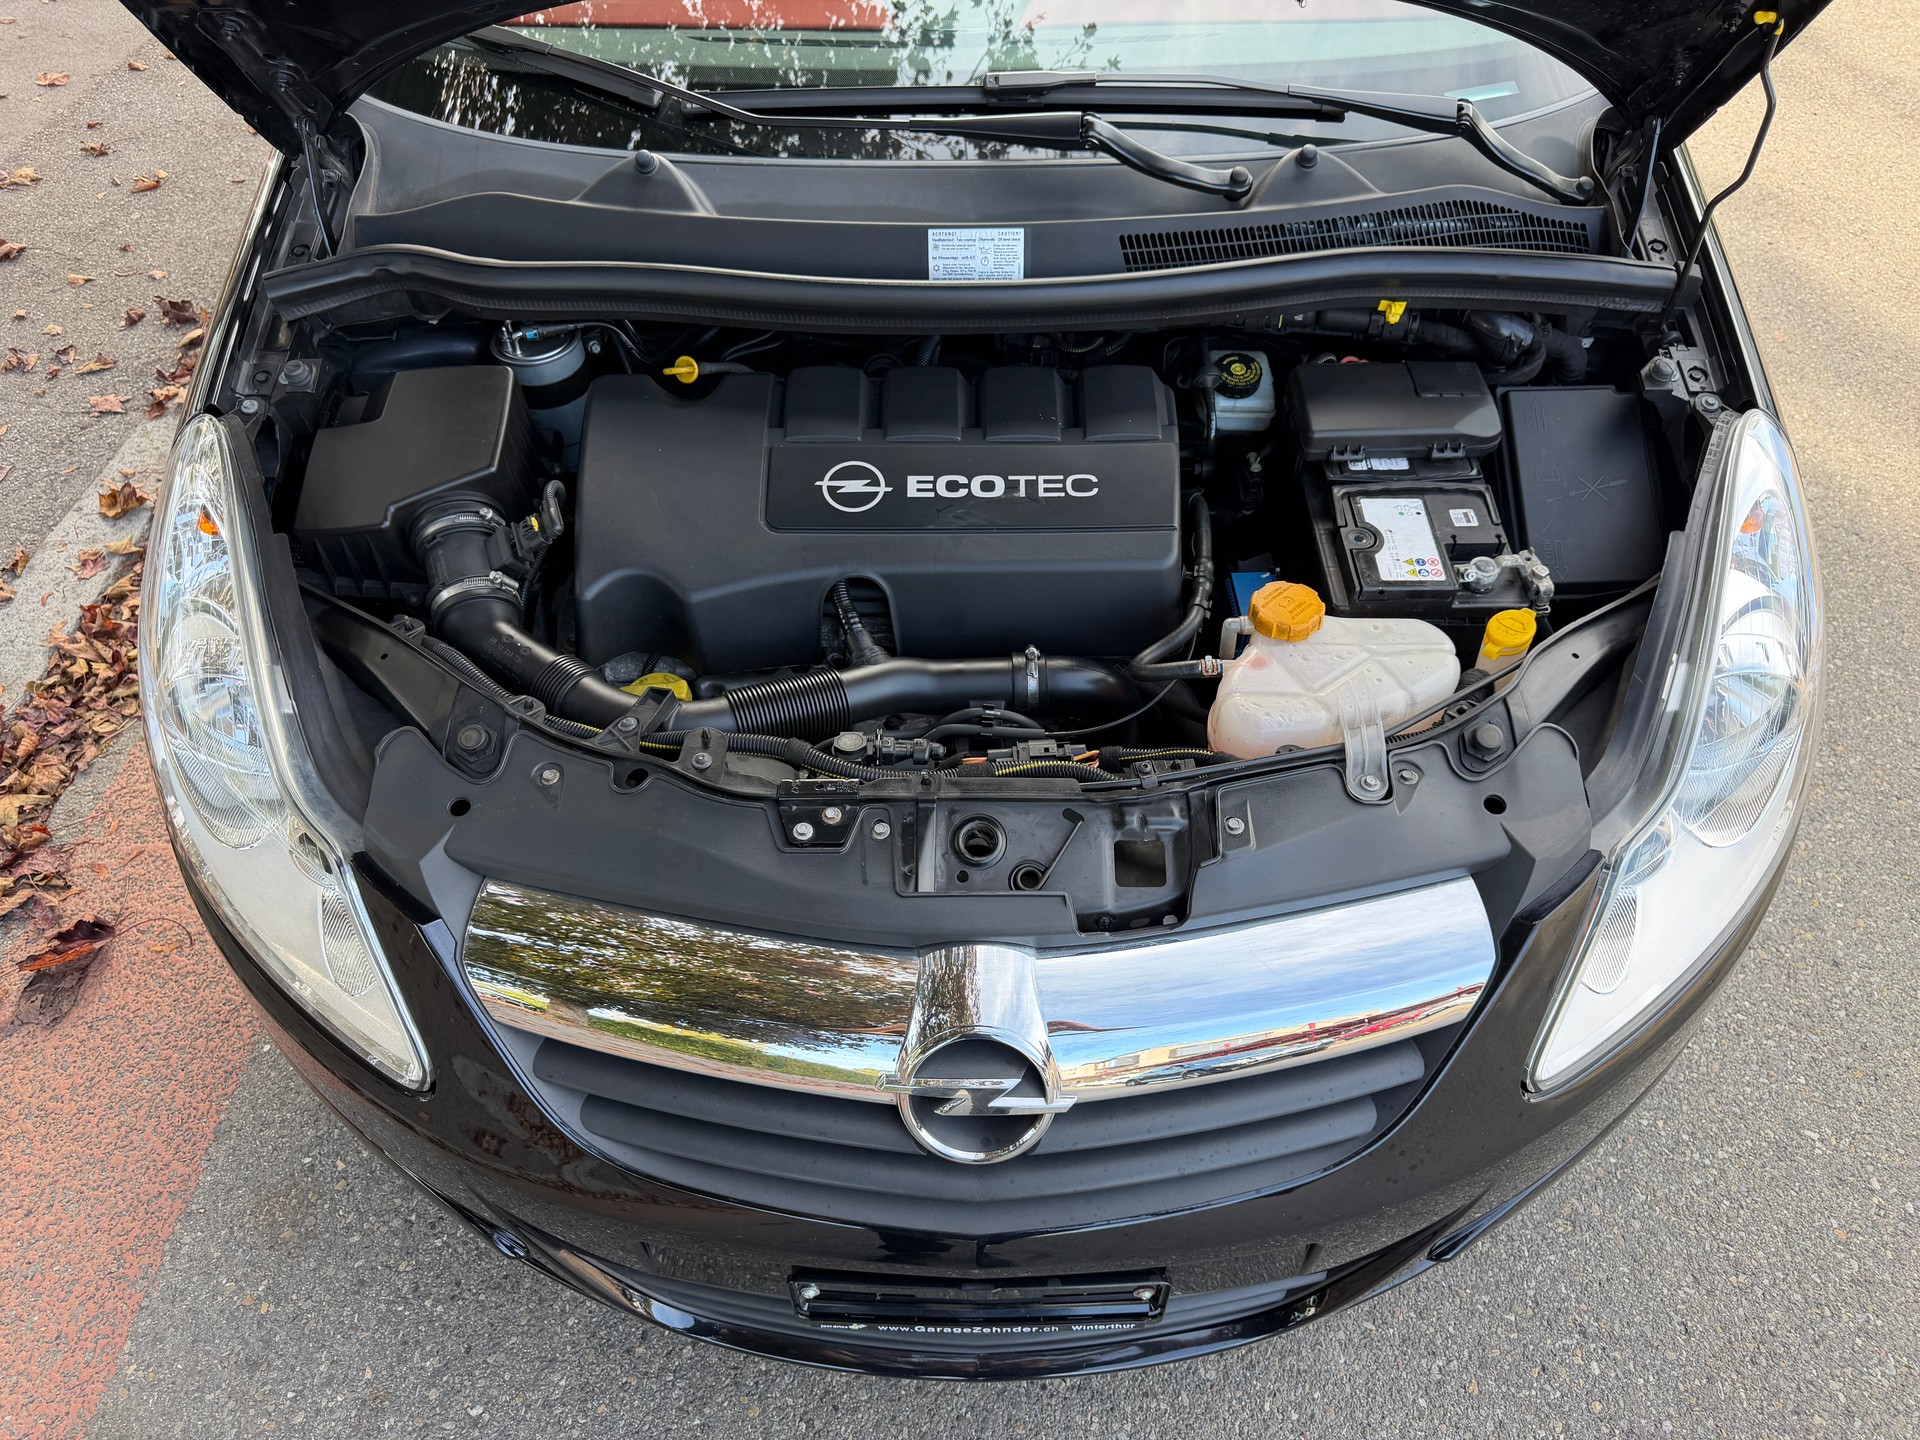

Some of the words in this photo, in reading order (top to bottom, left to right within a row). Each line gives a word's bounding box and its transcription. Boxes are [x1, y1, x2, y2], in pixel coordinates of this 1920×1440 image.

[907, 474, 1099, 498] ECOTEC
[878, 1325, 1059, 1334] www.GarageZehnder.ch
[1071, 1323, 1136, 1331] Winterthur
